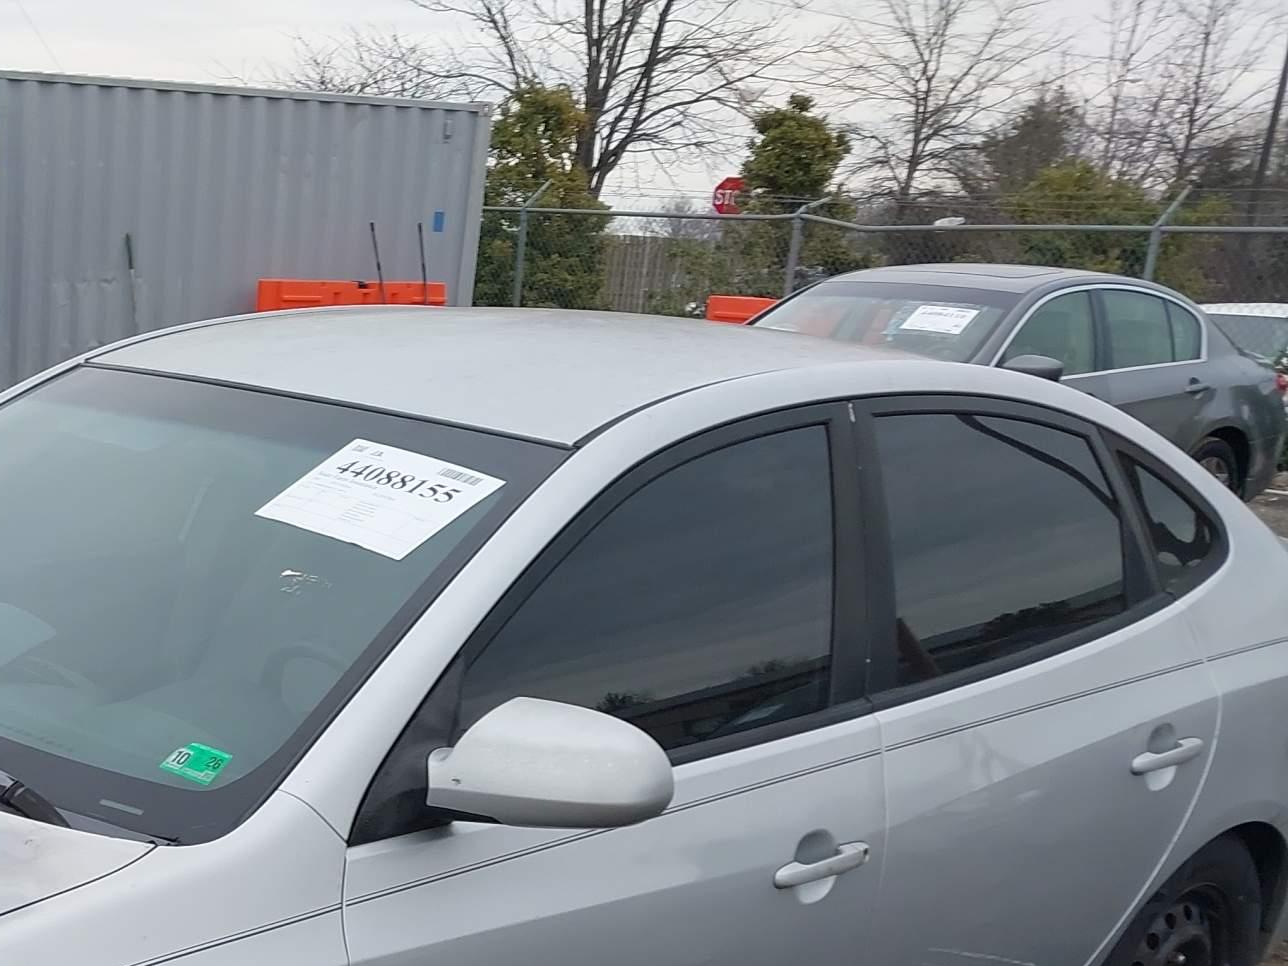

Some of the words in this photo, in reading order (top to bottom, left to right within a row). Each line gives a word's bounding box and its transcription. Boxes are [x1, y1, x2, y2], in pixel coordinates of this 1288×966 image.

[336, 460, 462, 503] 44088155
[171, 750, 192, 766] 10
[206, 756, 225, 770] 26
